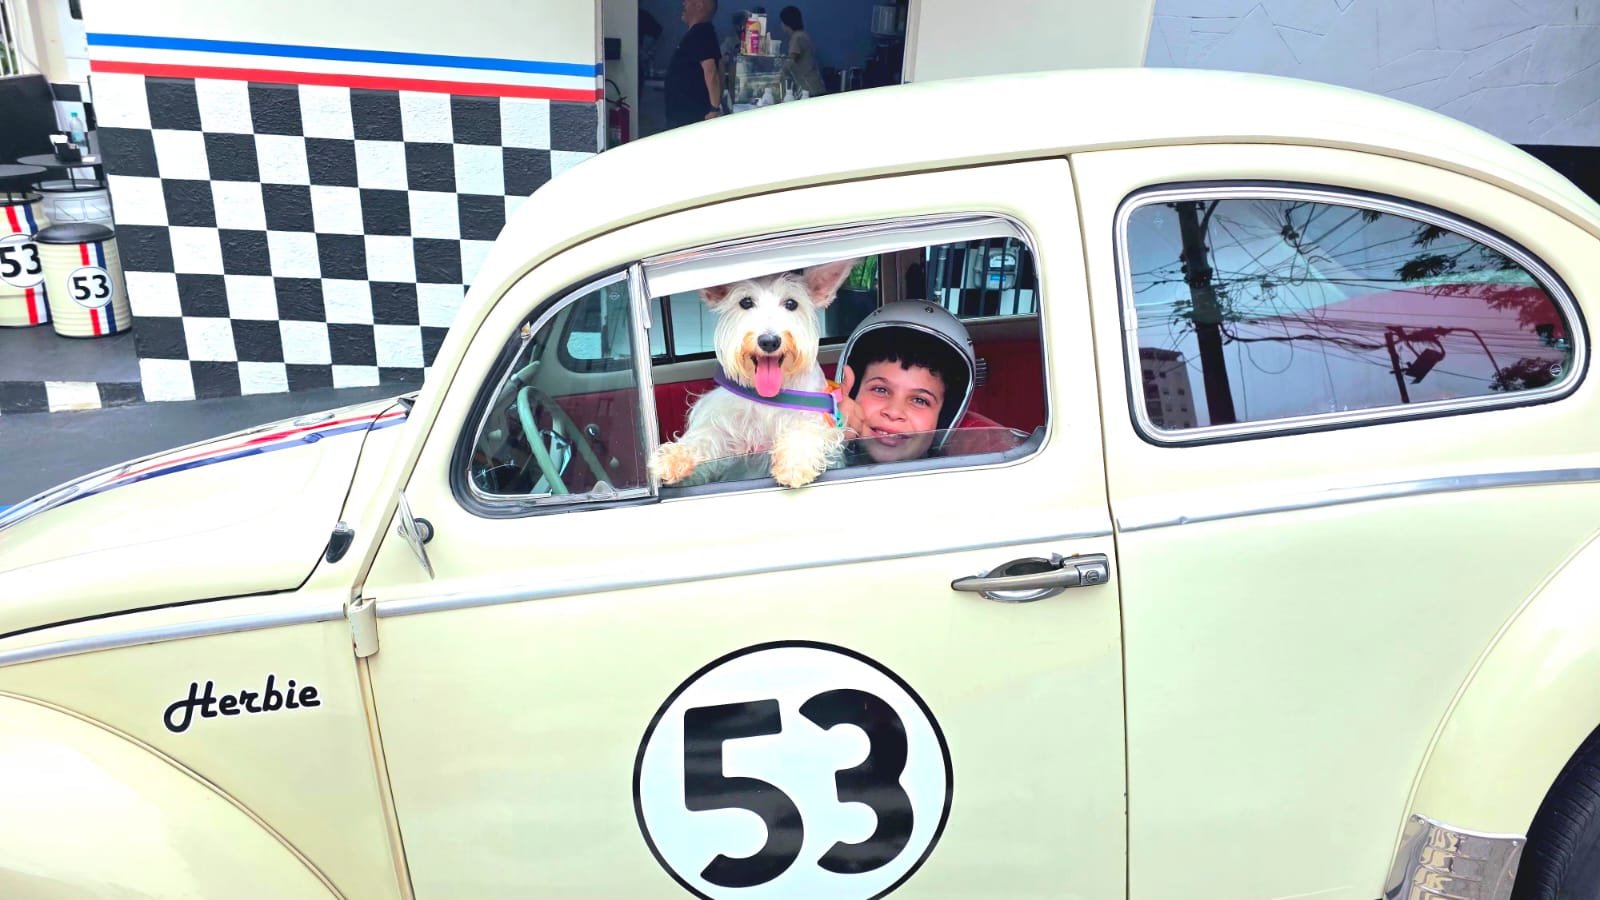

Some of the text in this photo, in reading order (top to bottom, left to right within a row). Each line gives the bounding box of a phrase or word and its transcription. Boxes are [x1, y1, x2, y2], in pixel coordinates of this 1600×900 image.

[0, 244, 42, 278] 53
[72, 274, 110, 301] 53
[163, 673, 321, 733] Herbie
[684, 688, 914, 888] 53
